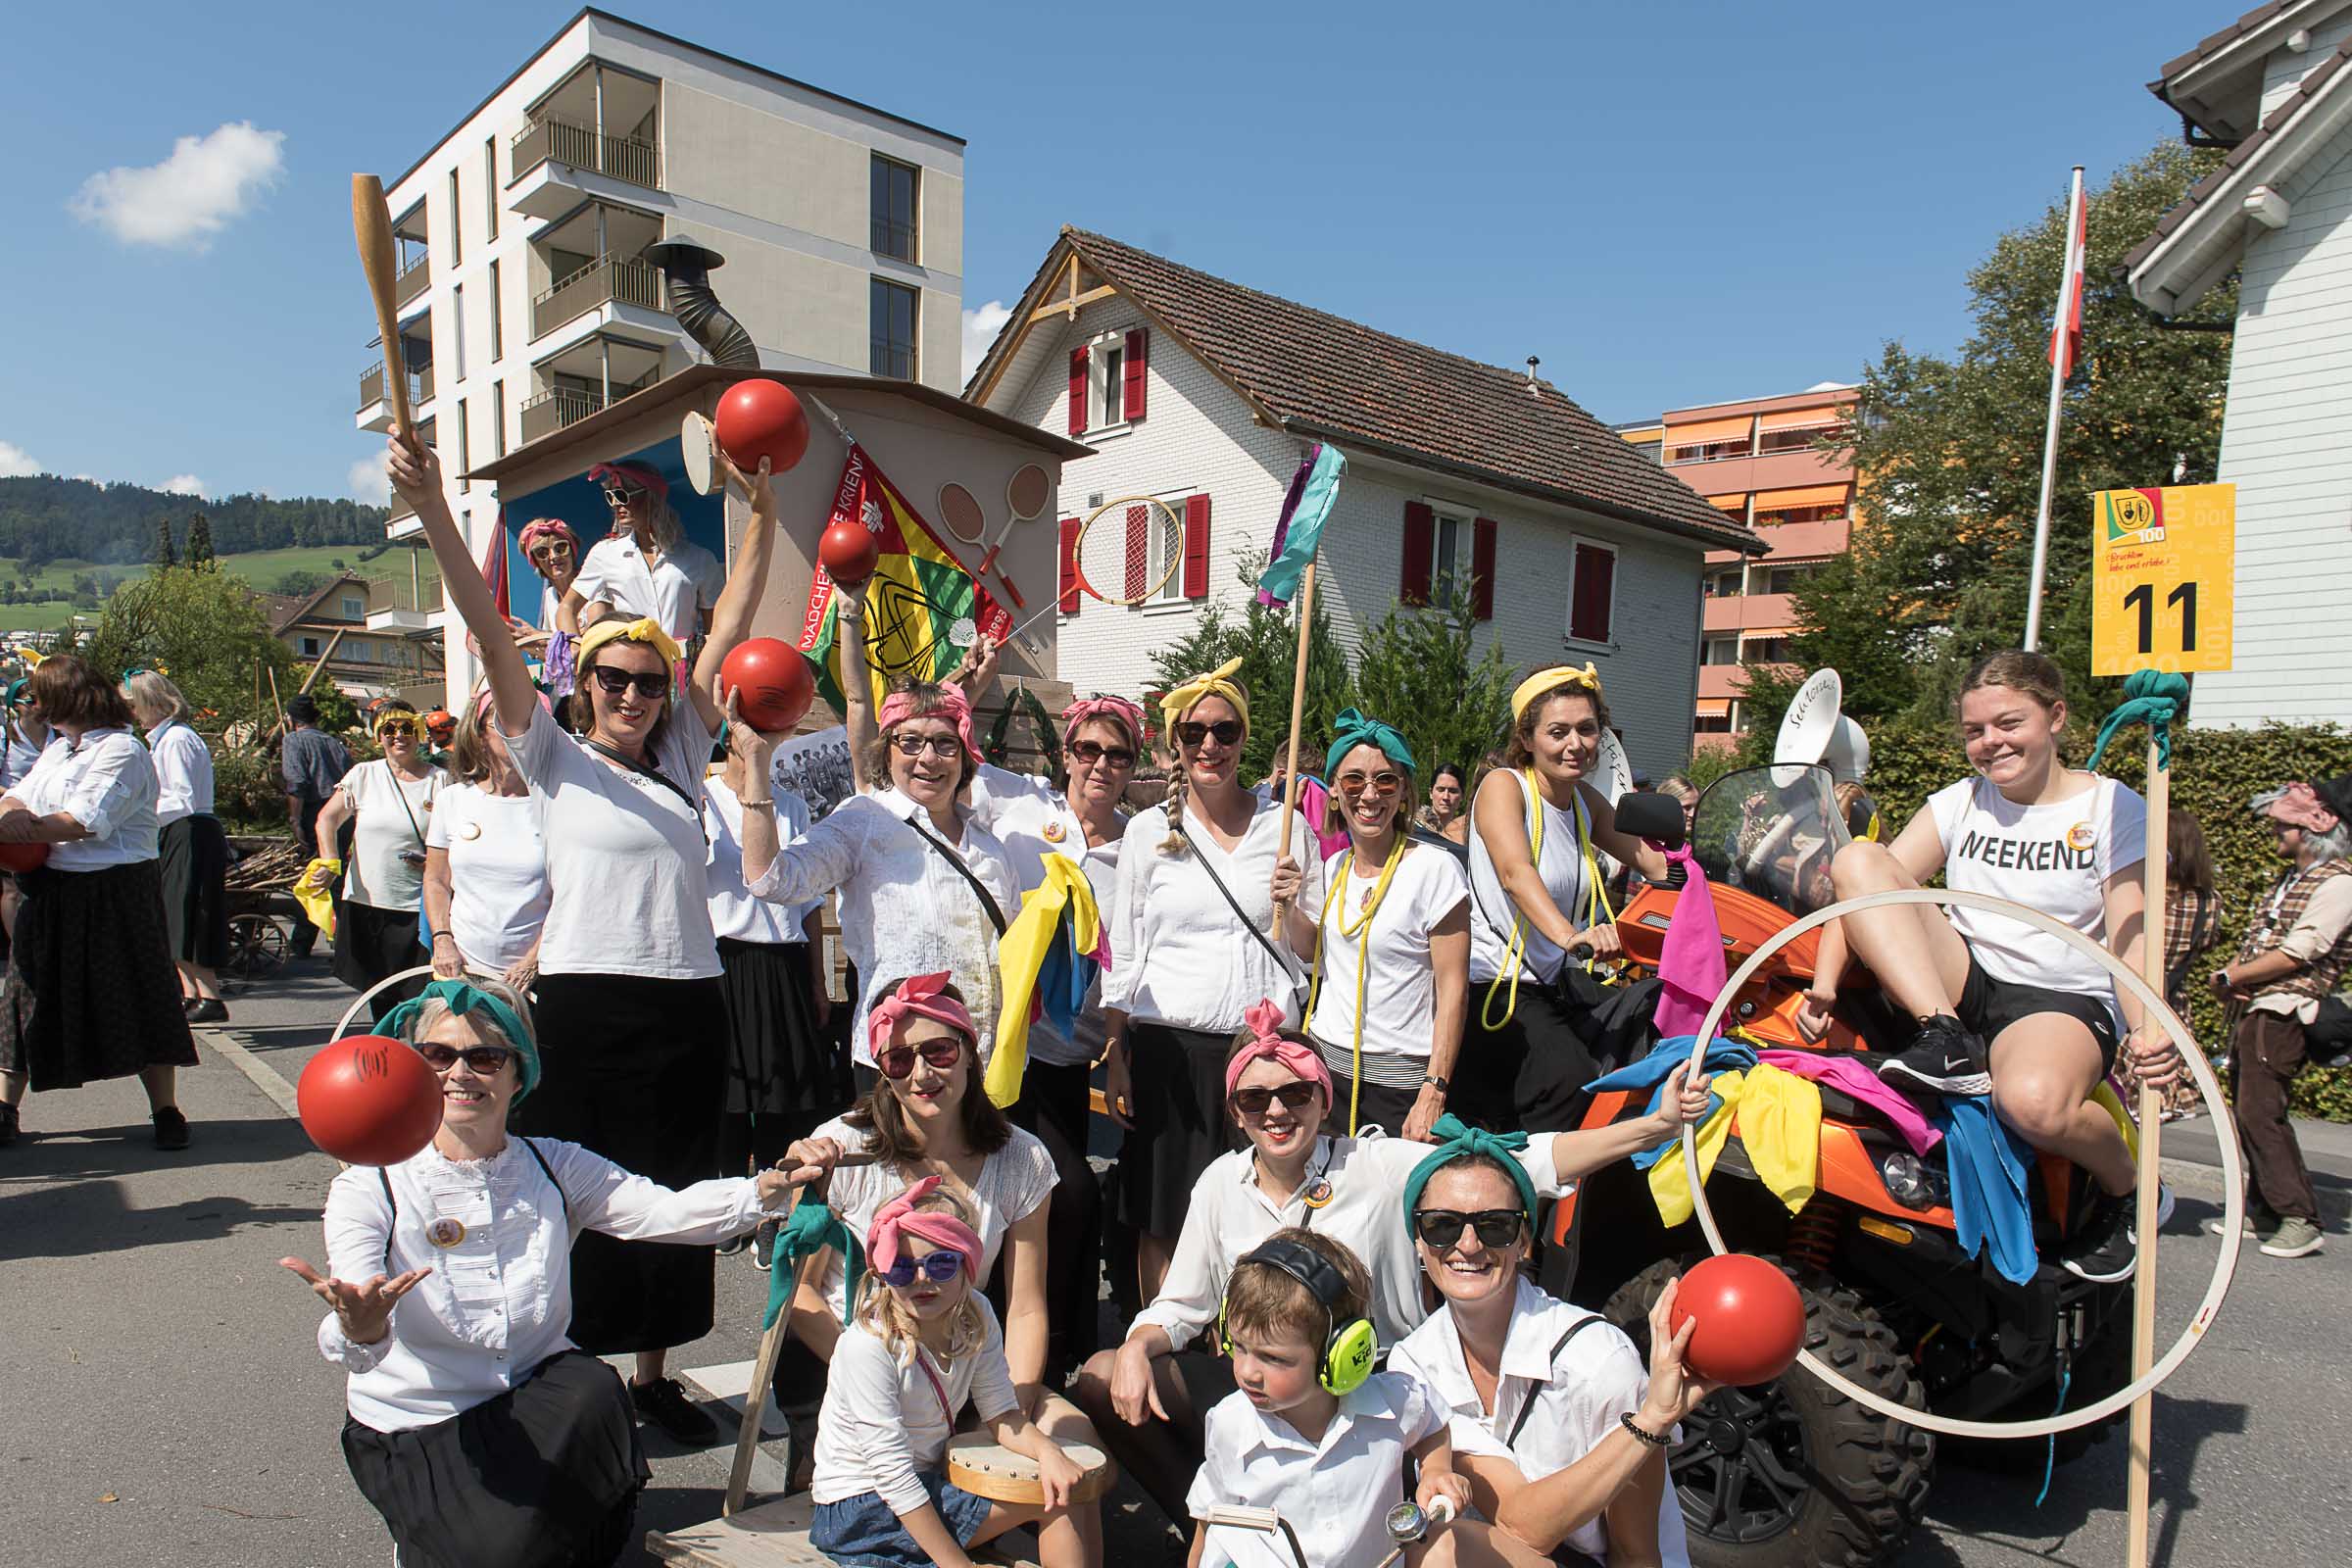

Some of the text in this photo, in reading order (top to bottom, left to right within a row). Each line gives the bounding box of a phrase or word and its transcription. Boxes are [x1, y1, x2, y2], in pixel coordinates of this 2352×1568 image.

[2139, 526, 2165, 544] 100
[2124, 581, 2197, 654] 11
[1959, 829, 2096, 871] WEEKEND
[1351, 1343, 1372, 1367] kid
